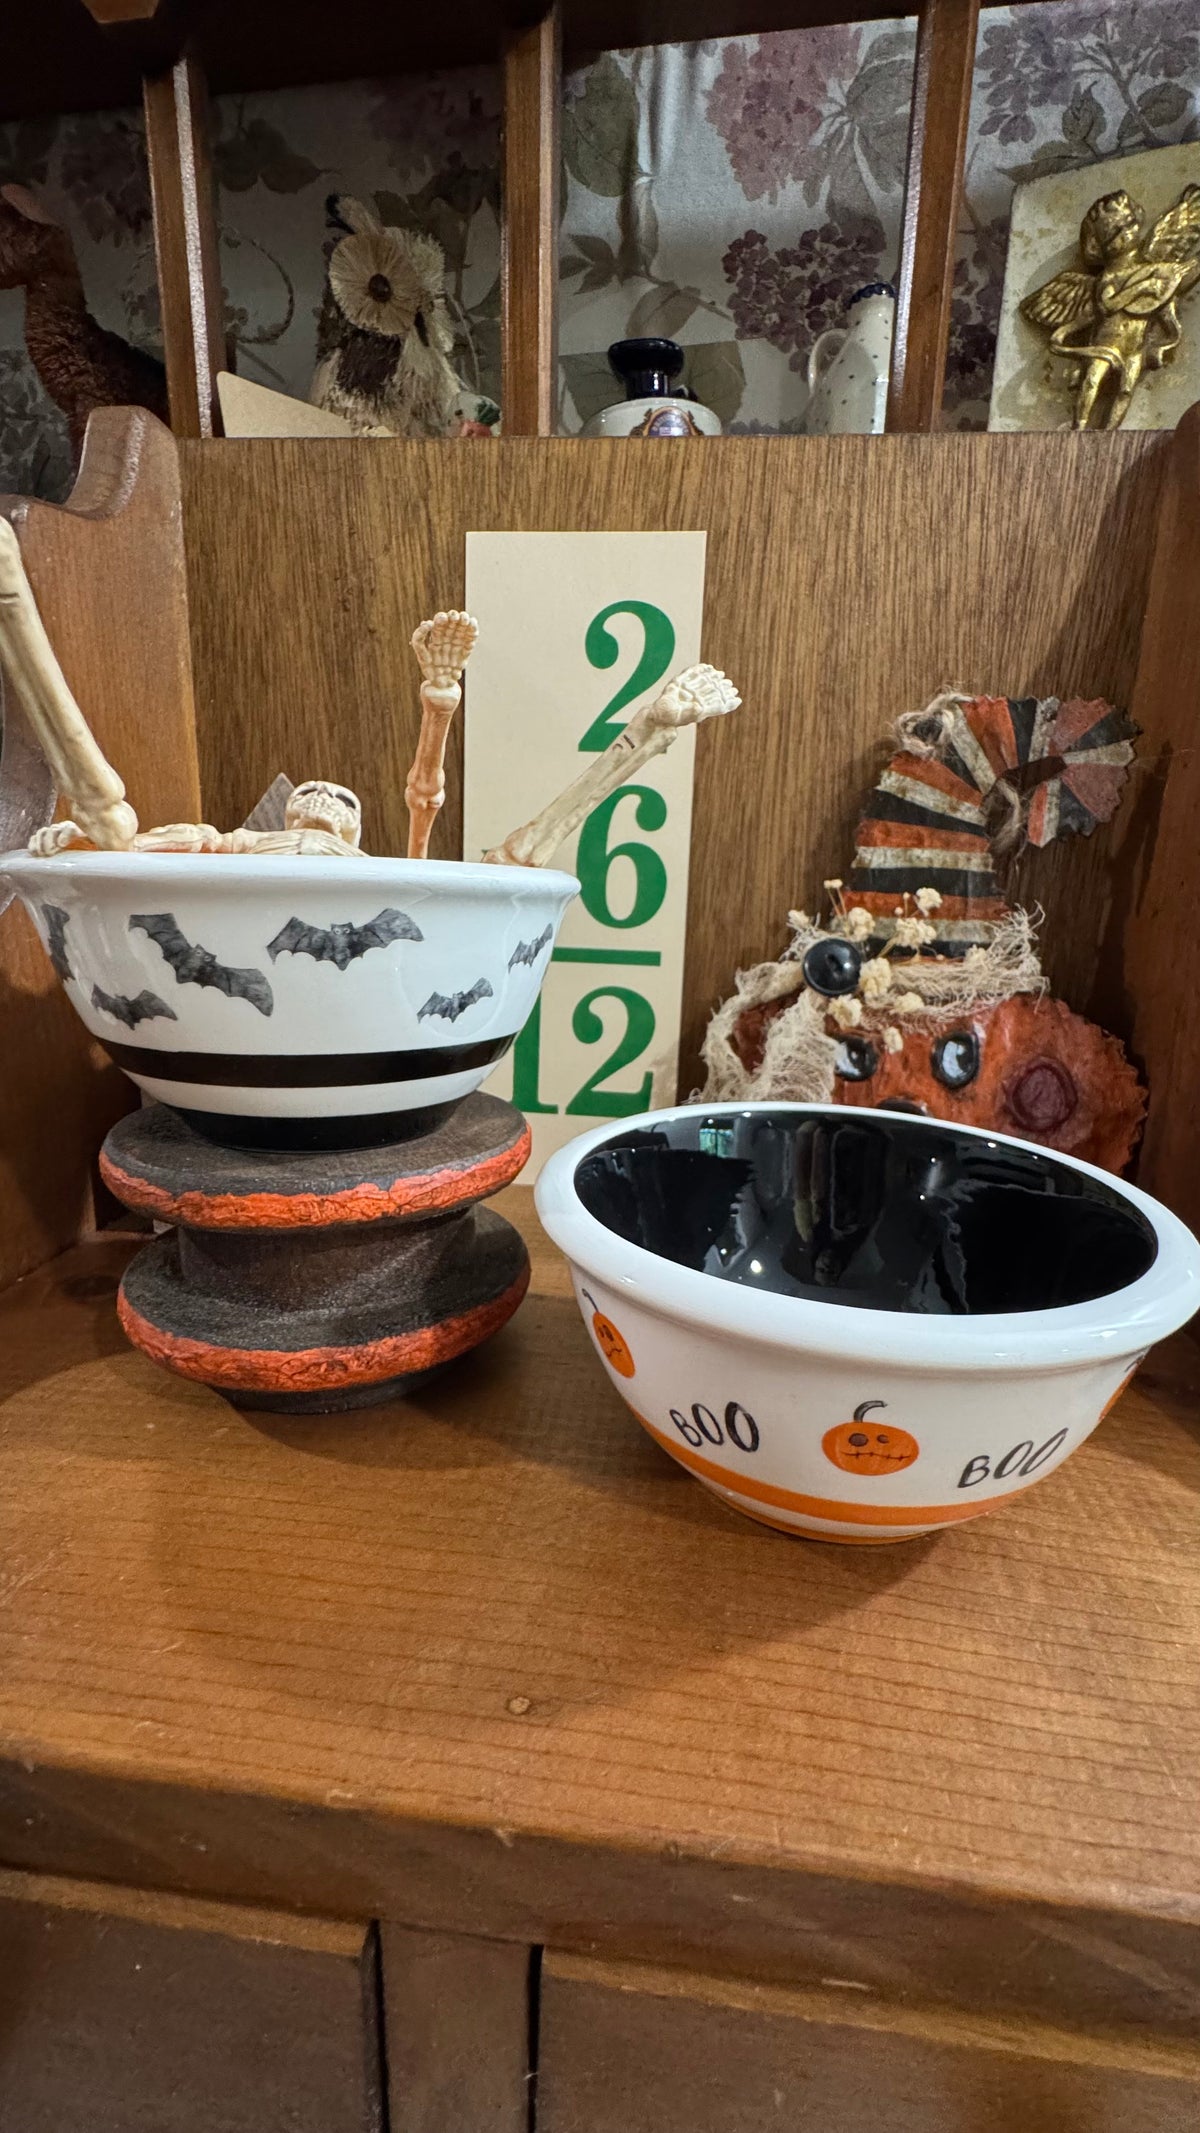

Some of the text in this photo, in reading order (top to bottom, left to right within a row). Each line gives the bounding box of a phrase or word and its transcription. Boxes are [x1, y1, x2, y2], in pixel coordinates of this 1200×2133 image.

[578, 600, 676, 753] 2
[576, 784, 668, 929] 6
[508, 985, 656, 1118] 12
[669, 1401, 760, 1453] BOO
[957, 1428, 1069, 1489] BOO
